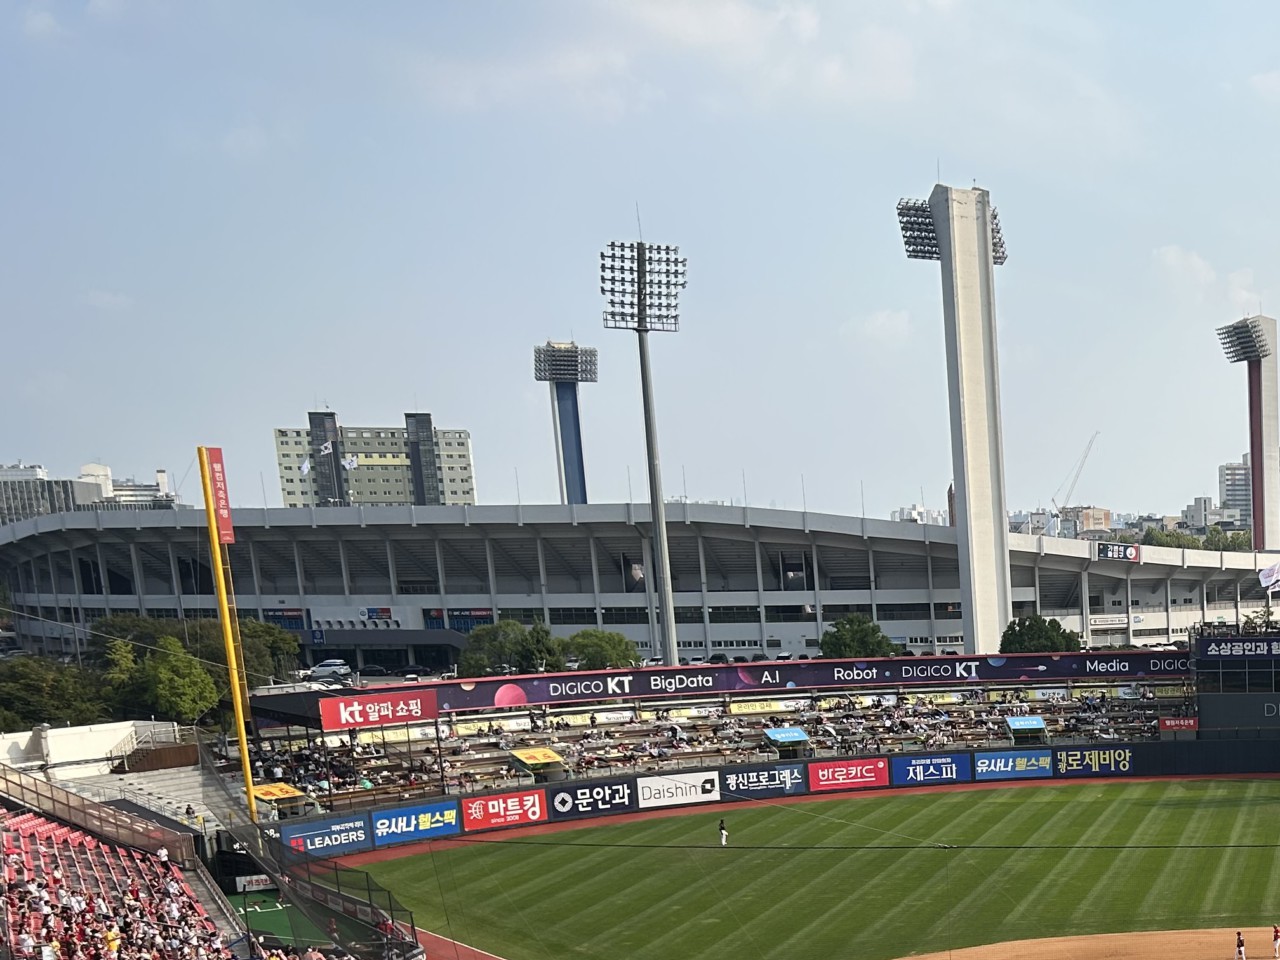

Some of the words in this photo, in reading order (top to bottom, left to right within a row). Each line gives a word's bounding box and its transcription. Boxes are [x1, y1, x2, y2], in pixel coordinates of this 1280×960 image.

[1207, 642, 1268, 655] 소상공인과
[834, 667, 878, 681] Robot
[902, 665, 952, 678] DIGICO
[955, 662, 979, 677] KT
[1086, 660, 1129, 673] Media
[549, 681, 603, 697] DIGICO
[607, 676, 633, 695] KT
[650, 675, 713, 692] BigData
[761, 670, 779, 684] A.I
[339, 702, 364, 724] kt
[365, 702, 393, 721] 알파
[396, 699, 422, 717] 쇼핑
[906, 763, 958, 782] 제스파
[976, 758, 1013, 773] 유사나
[1015, 756, 1051, 771] 헬스팩
[725, 769, 802, 791] 광신프로그레스
[818, 765, 876, 784] 바로카드
[574, 784, 631, 812] 문안과
[641, 783, 698, 801] Daishin
[488, 794, 541, 821] 마트킹
[375, 815, 417, 837] 유사나
[418, 809, 457, 830] 헬스팩
[306, 830, 366, 850] LEADERS
